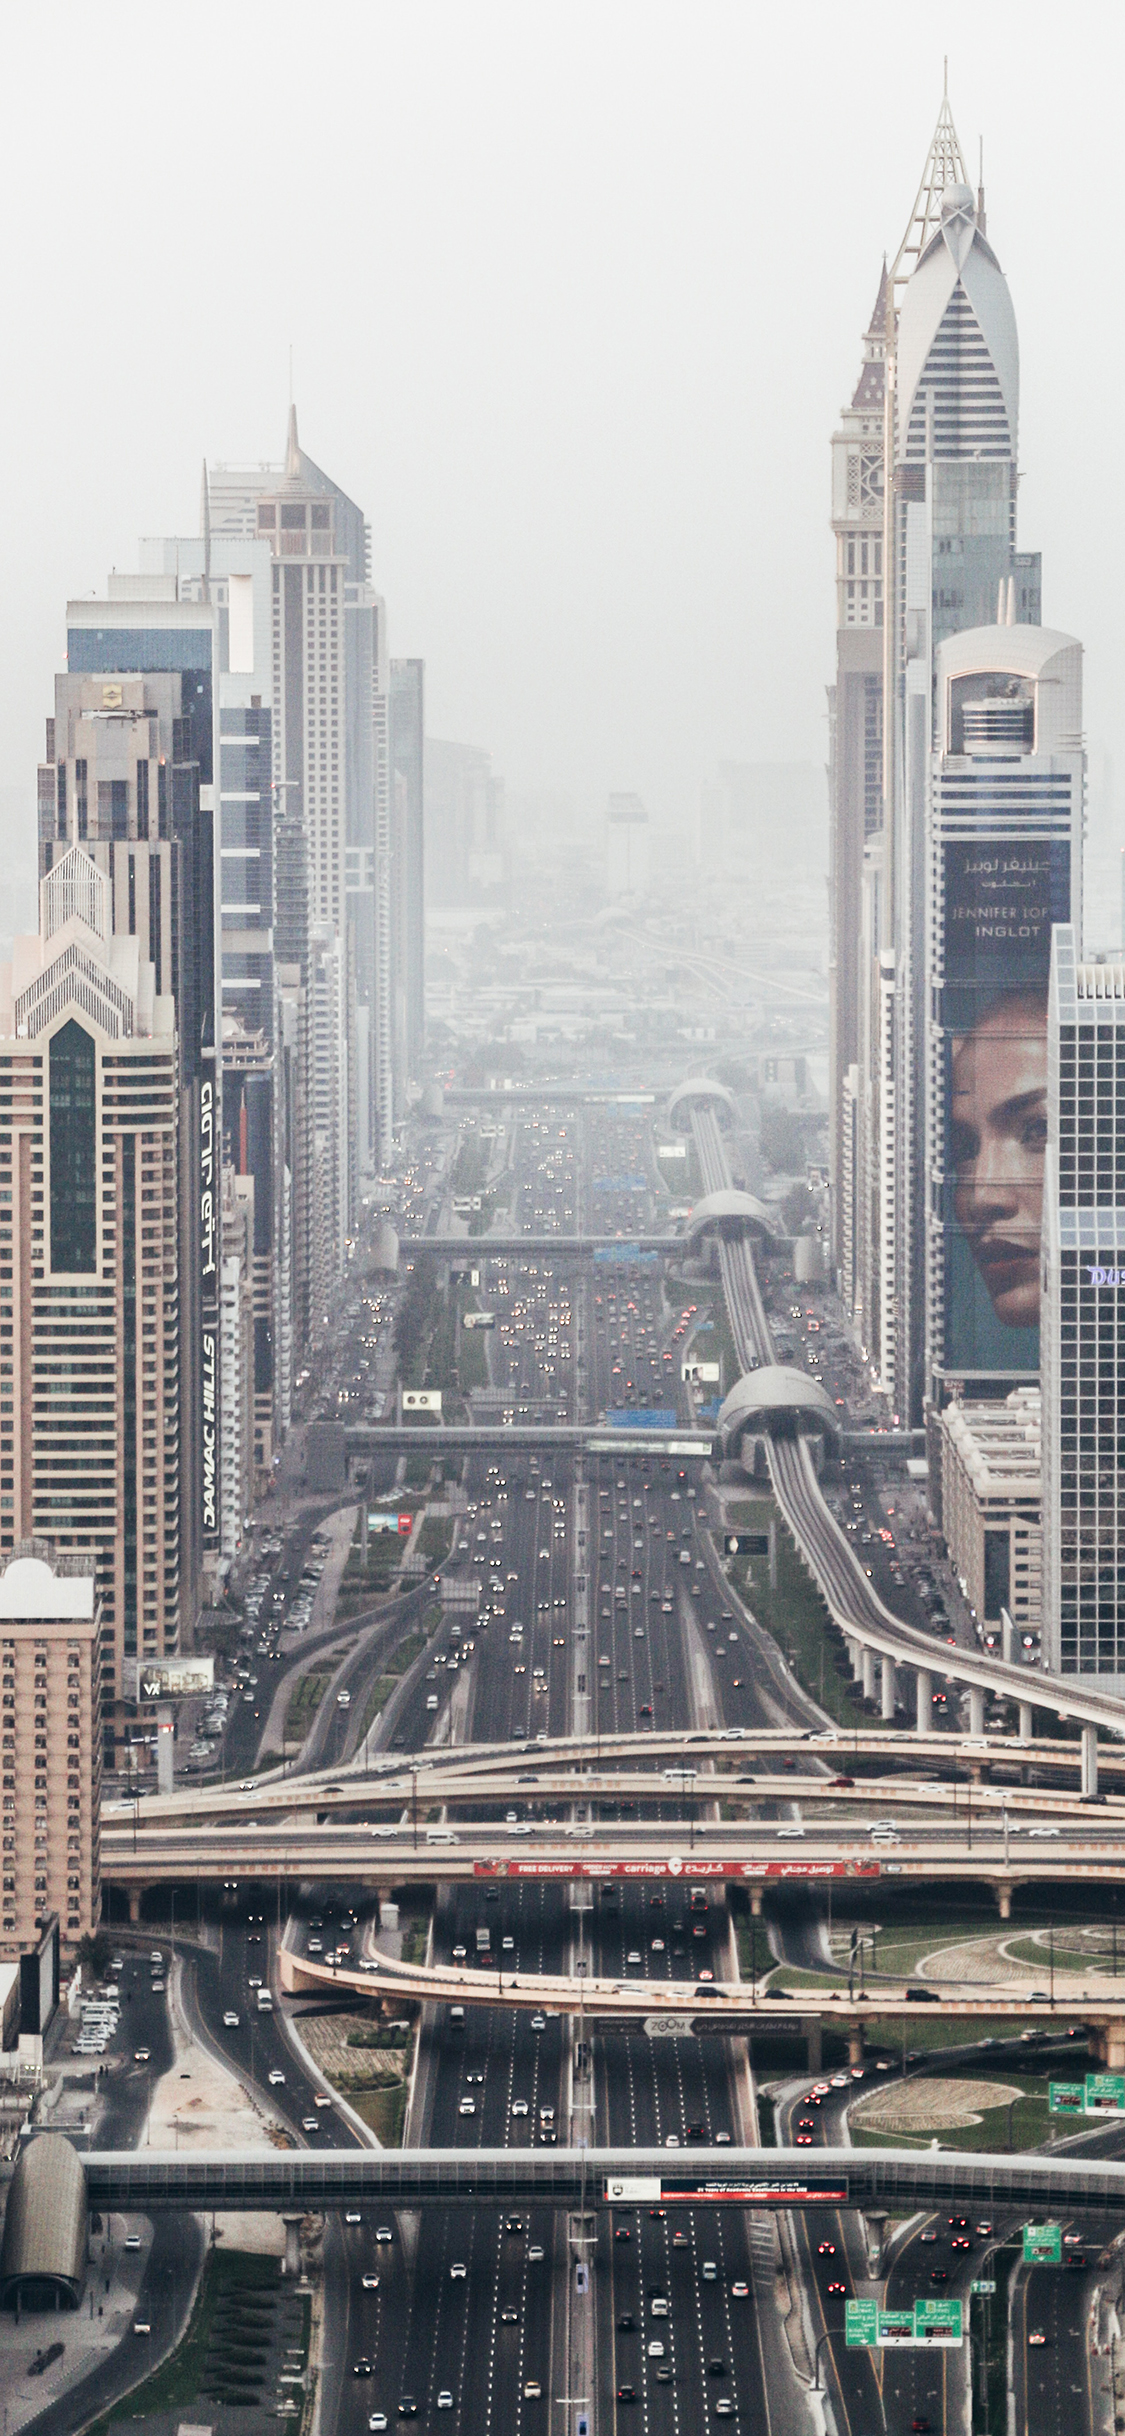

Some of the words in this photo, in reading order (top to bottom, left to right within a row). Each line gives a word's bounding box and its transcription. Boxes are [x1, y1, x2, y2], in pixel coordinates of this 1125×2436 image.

[952, 906, 1017, 920] JENNIFER
[976, 925, 1041, 938] INGLOT
[201, 1081, 213, 1186] داماك
[201, 1190, 216, 1276] هيلز
[203, 1334, 216, 1423] HILLS
[203, 1425, 216, 1529] DAMAC
[518, 1865, 537, 1873] FREE
[538, 1865, 574, 1873] DELIVERY
[624, 1863, 666, 1875] carriage
[781, 1865, 808, 1876] مجاني
[808, 1864, 834, 1874] توصيل
[651, 2018, 686, 2032] ZOOM
